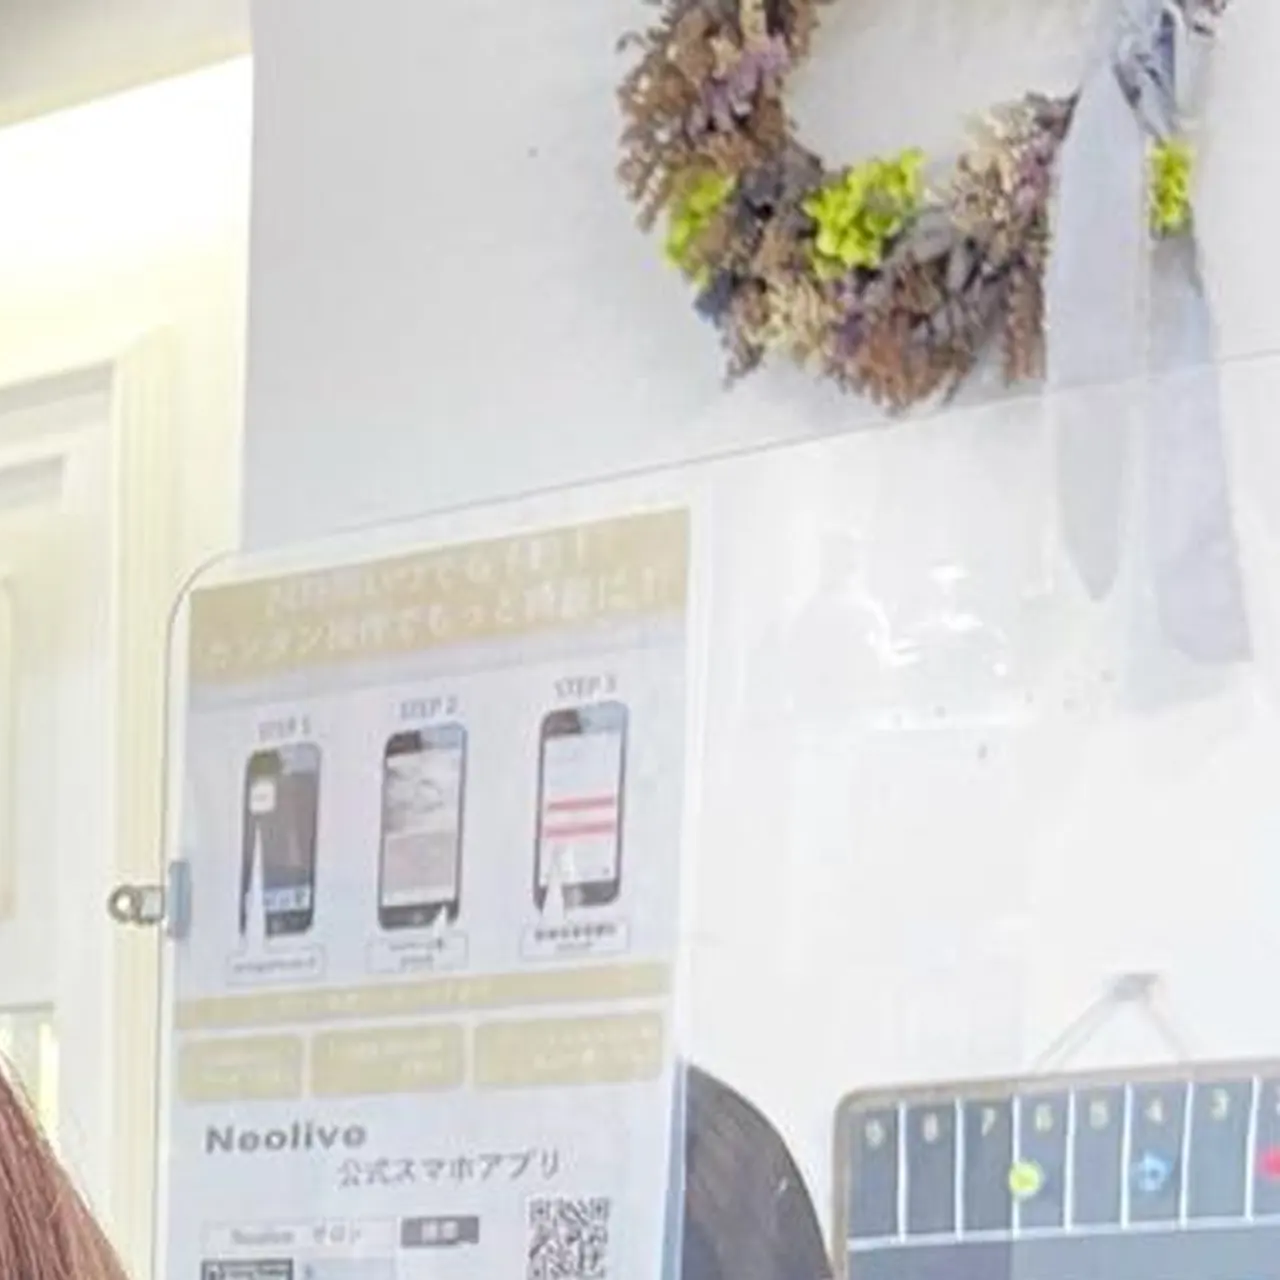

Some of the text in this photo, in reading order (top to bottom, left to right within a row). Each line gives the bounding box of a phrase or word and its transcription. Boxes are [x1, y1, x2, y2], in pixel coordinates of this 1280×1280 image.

[338, 1149, 561, 1188] 公式スマホアプリ
